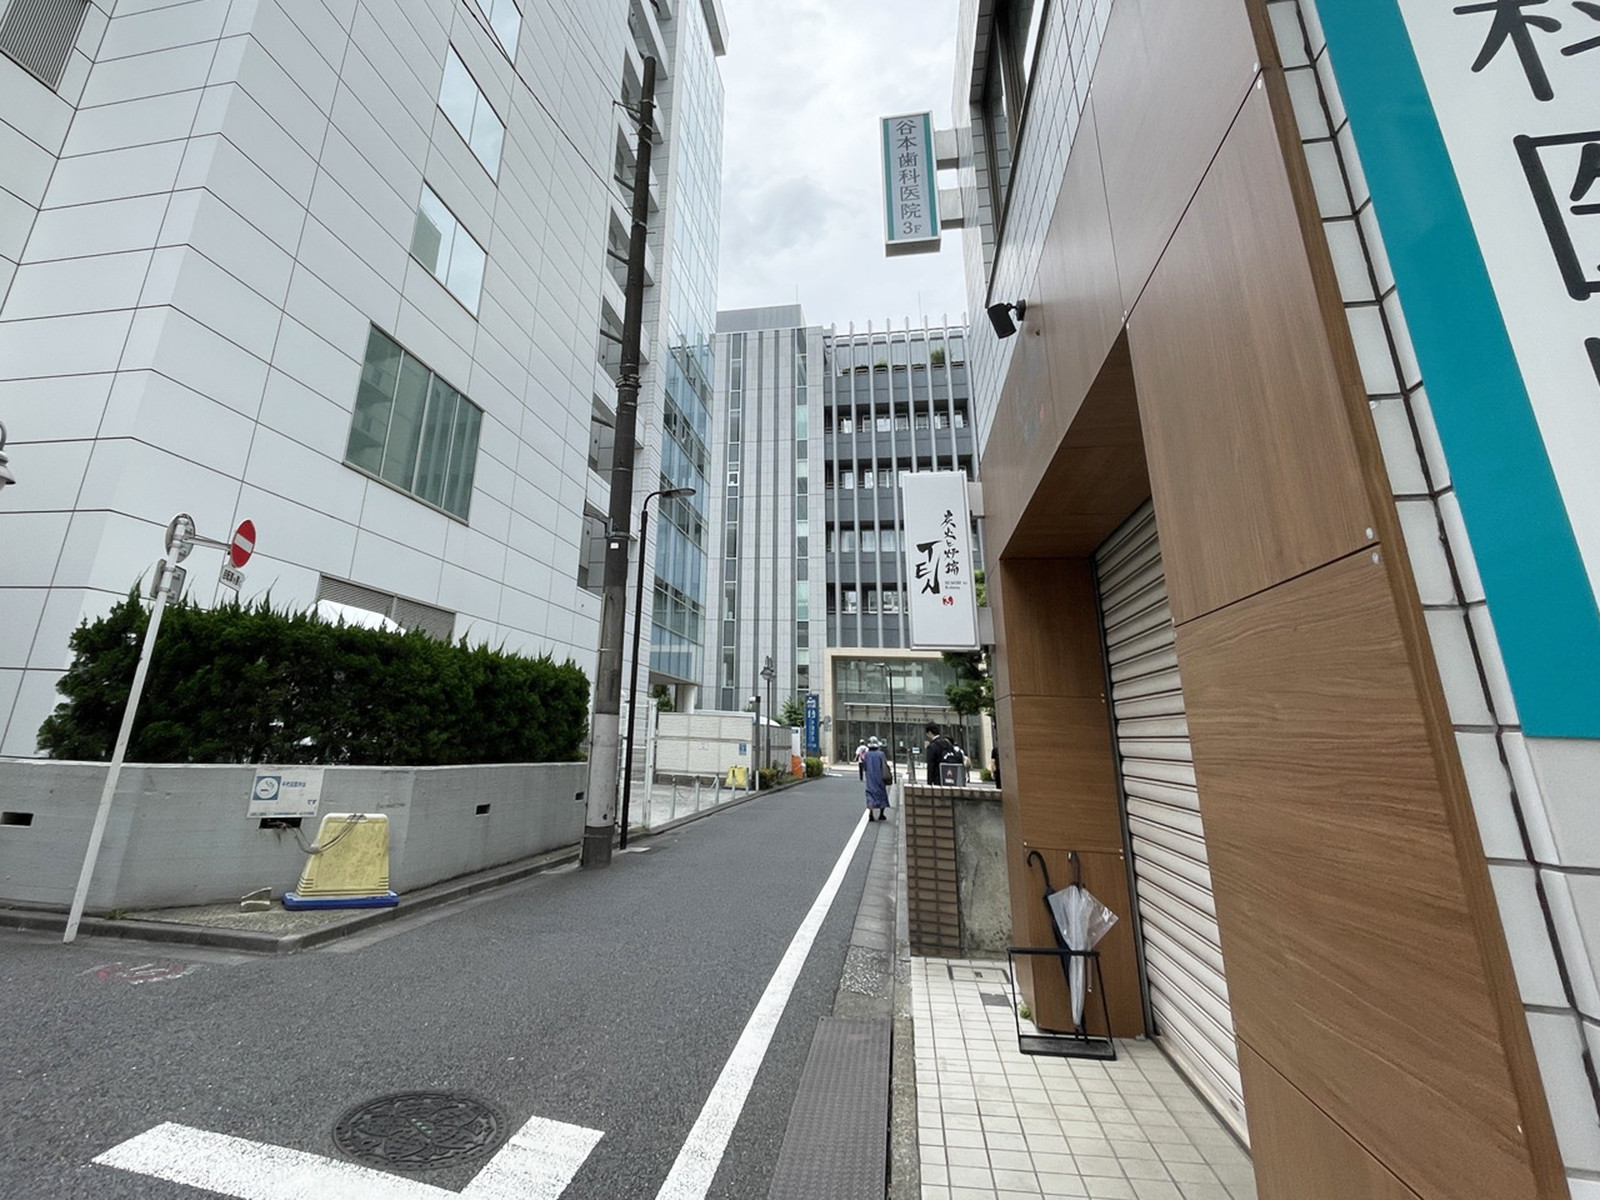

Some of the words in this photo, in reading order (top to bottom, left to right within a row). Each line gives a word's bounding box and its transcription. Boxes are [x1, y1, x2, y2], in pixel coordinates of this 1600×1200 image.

[896, 119, 922, 220] 谷本歯科医院
